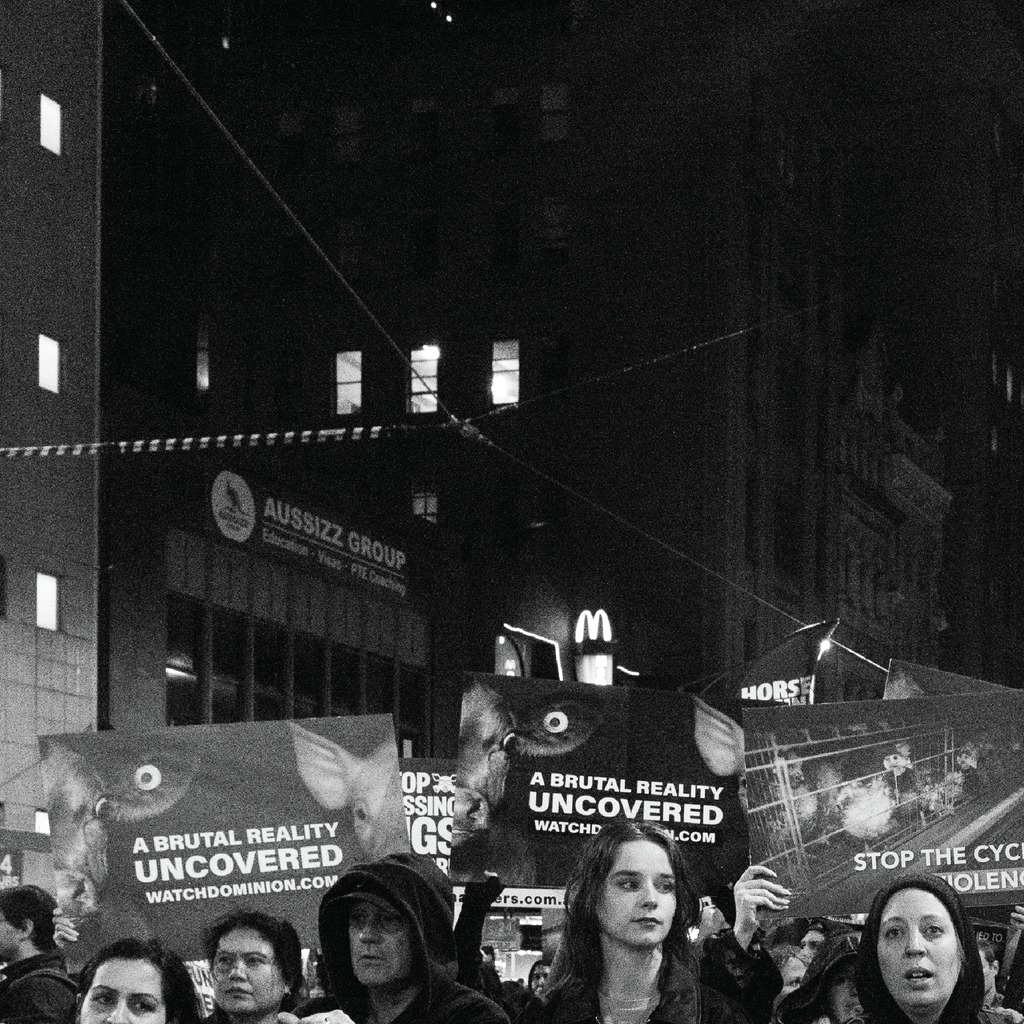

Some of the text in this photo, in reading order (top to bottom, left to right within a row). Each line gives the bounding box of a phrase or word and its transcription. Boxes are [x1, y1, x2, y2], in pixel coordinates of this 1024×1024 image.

[264, 498, 344, 547] AUSSIZZ
[348, 531, 406, 571] GROUP
[530, 772, 724, 800] A BRUTAL REALITY
[528, 791, 724, 825] UNCOVERED
[132, 822, 339, 854] A BRUTAL REALITY
[134, 845, 343, 883] UNCOVERED
[854, 851, 914, 871] STOP
[921, 847, 967, 866] THE
[146, 875, 338, 903] WATCHDOMINION.COM
[991, 932, 1003, 942] TO
